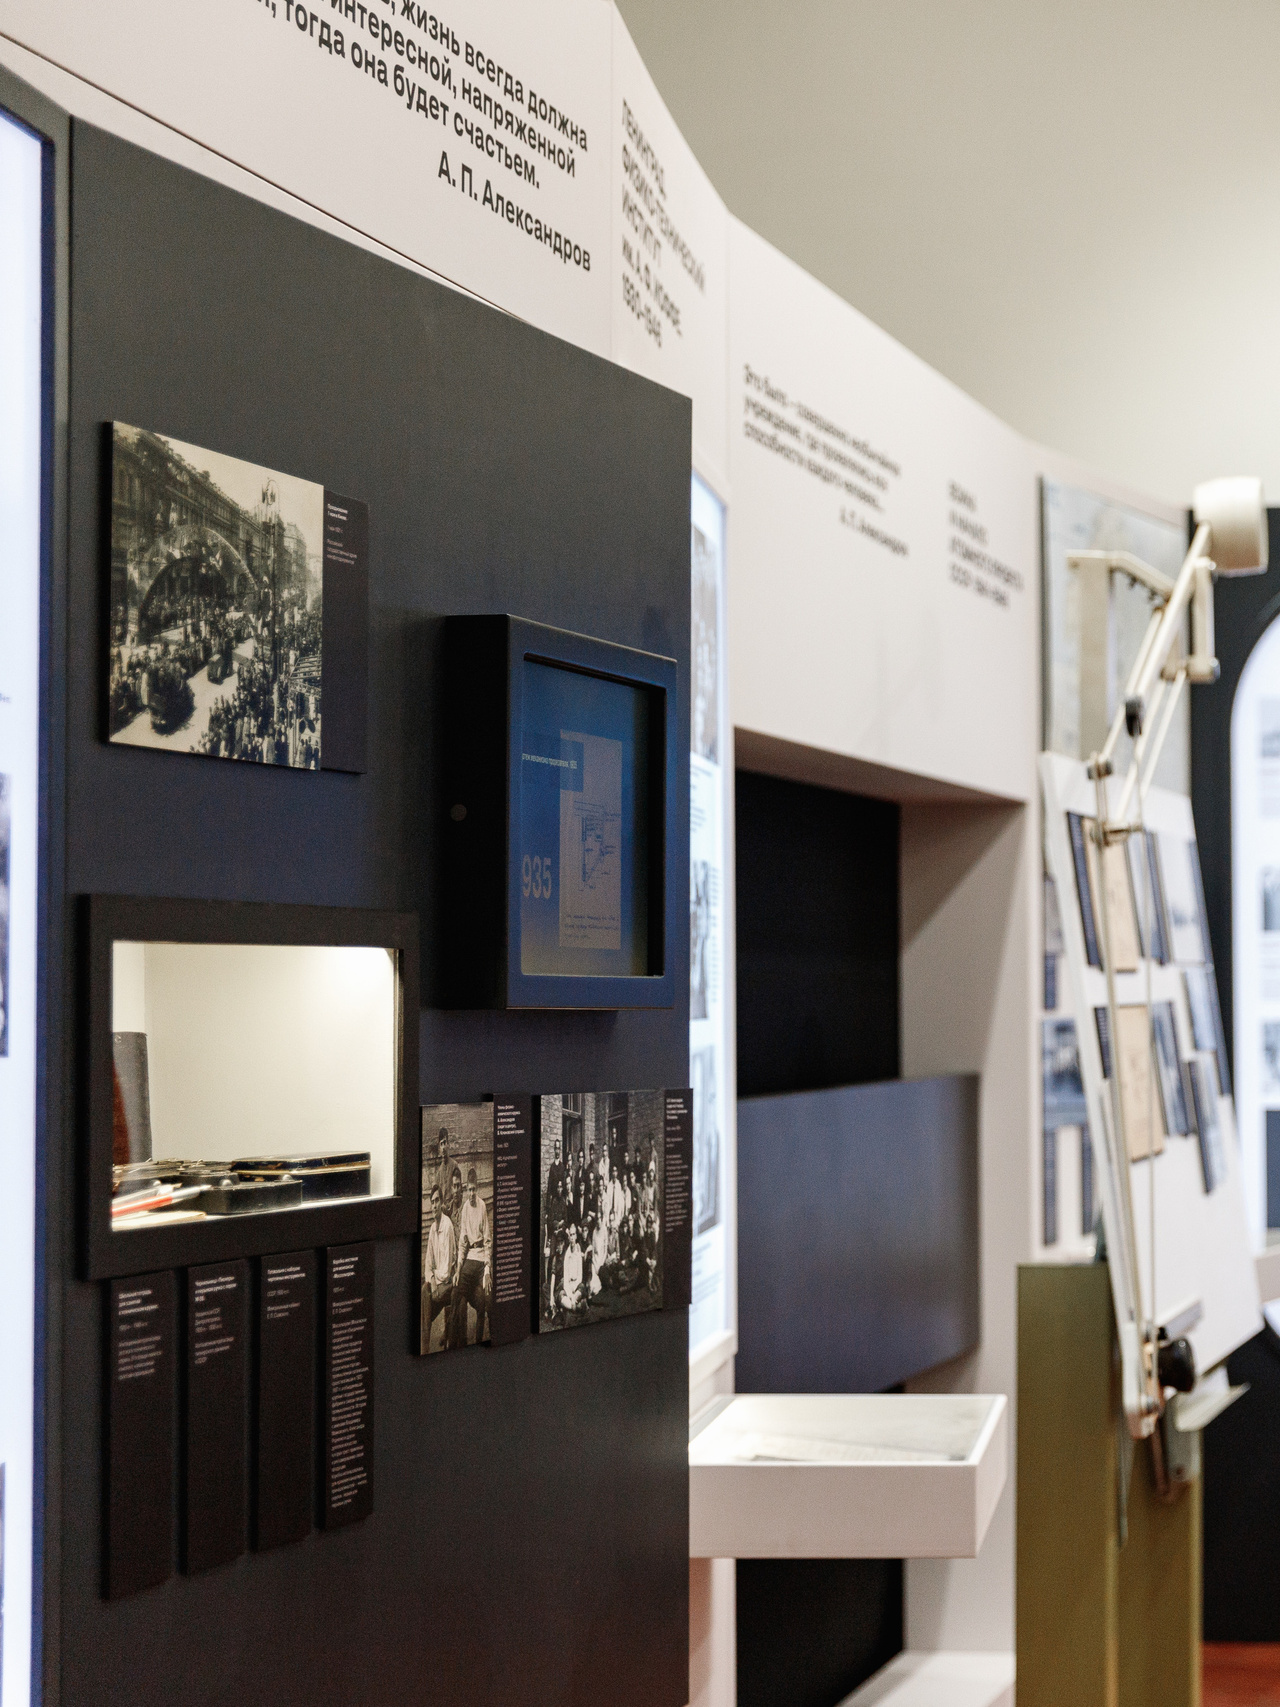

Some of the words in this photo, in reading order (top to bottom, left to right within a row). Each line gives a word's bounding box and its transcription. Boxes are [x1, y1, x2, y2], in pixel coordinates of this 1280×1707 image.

[284, 0, 346, 59] тогда
[351, 42, 389, 87] она
[393, 64, 449, 126] будет
[454, 112, 540, 189] счастьем.
[401, 0, 460, 56] жизнь
[465, 41, 524, 105] всегда
[528, 90, 587, 152] должна
[462, 78, 576, 178] напряженной
[438, 151, 456, 187] А.
[461, 163, 478, 201] П.
[482, 179, 591, 272] Александров
